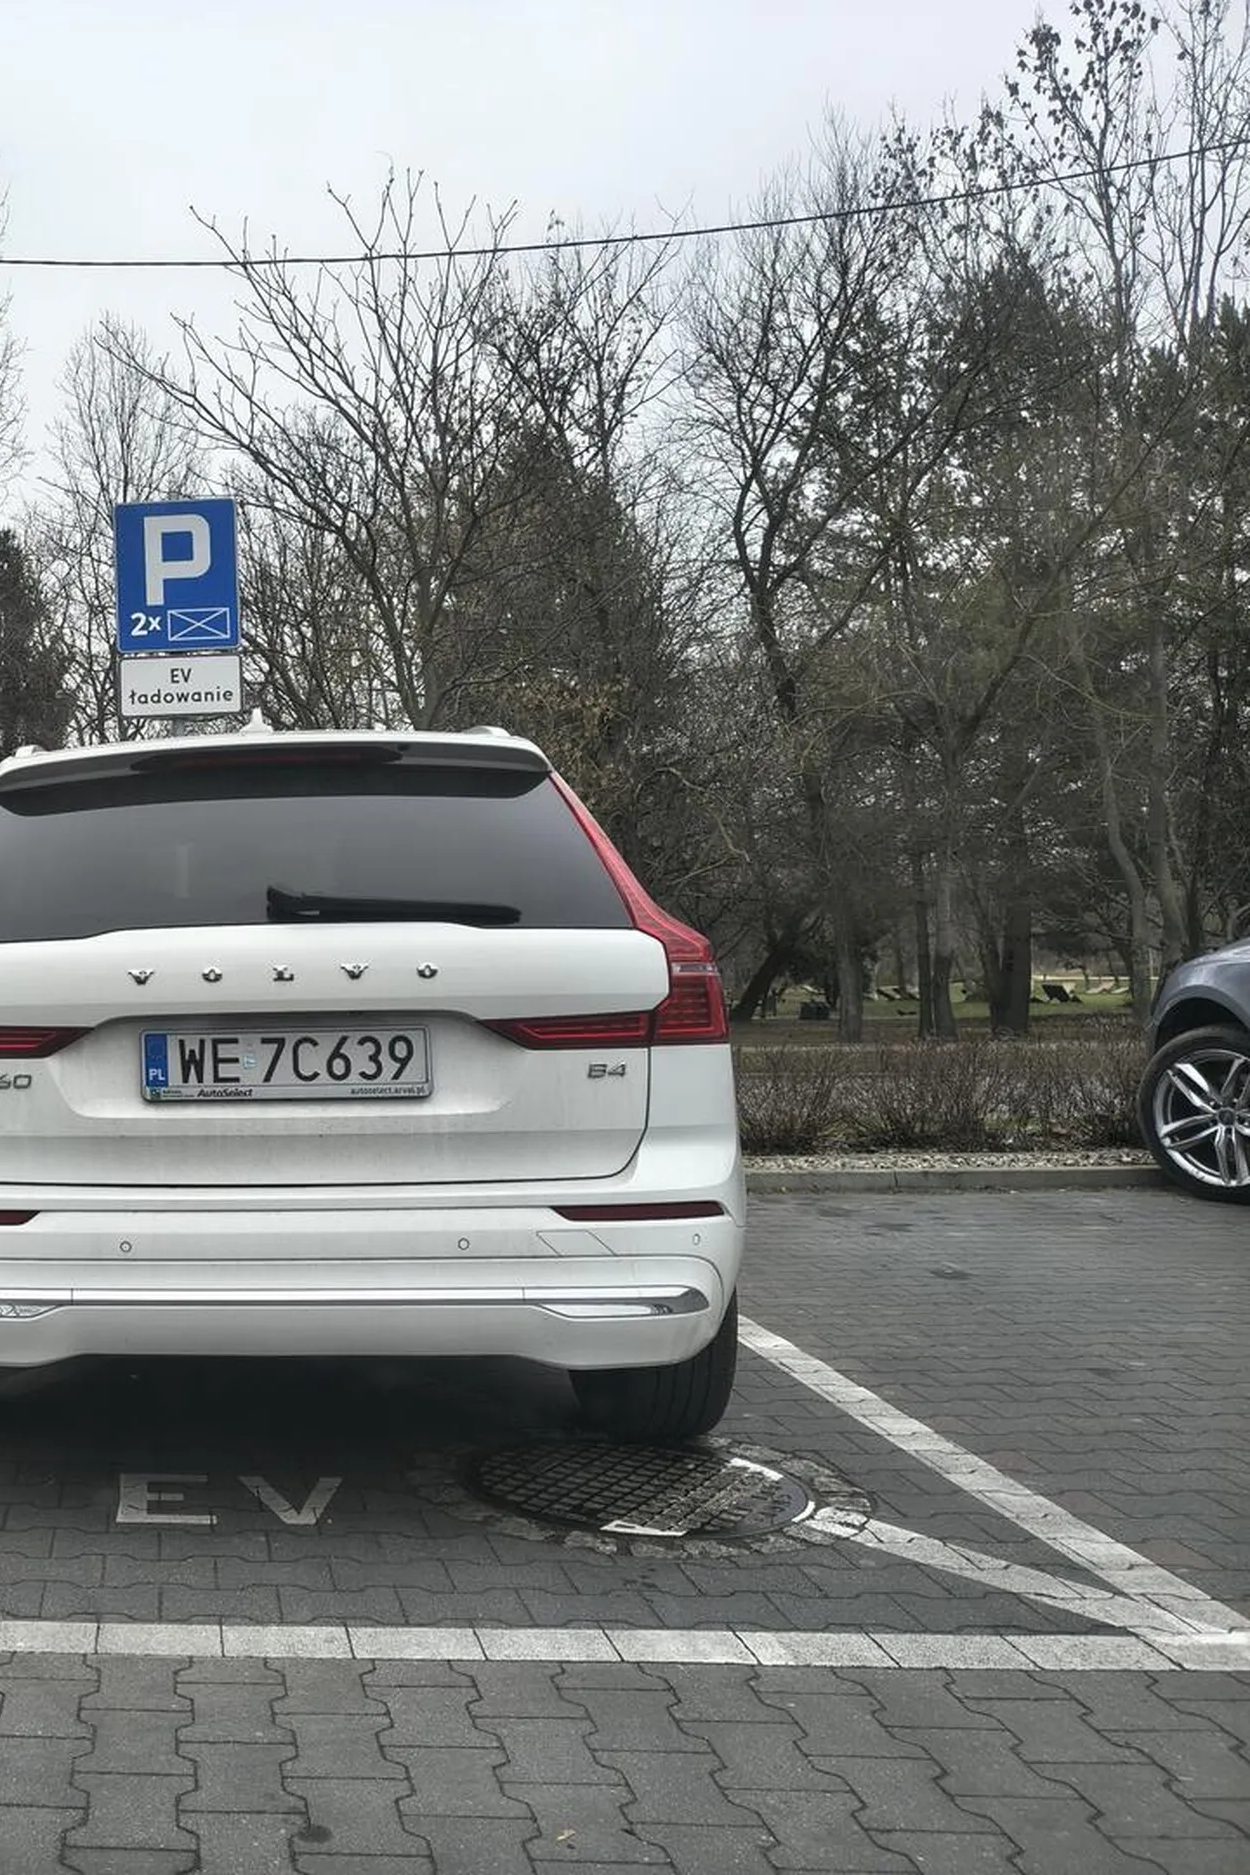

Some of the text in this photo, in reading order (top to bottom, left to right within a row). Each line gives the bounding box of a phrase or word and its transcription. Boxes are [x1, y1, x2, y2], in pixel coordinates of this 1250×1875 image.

[144, 514, 210, 606] P
[130, 611, 161, 637] 2x
[170, 668, 192, 684] EV
[129, 686, 233, 705] ładowanie
[178, 1035, 414, 1083] WE 7C639
[149, 1069, 166, 1081] PL
[116, 1474, 343, 1525] EV
